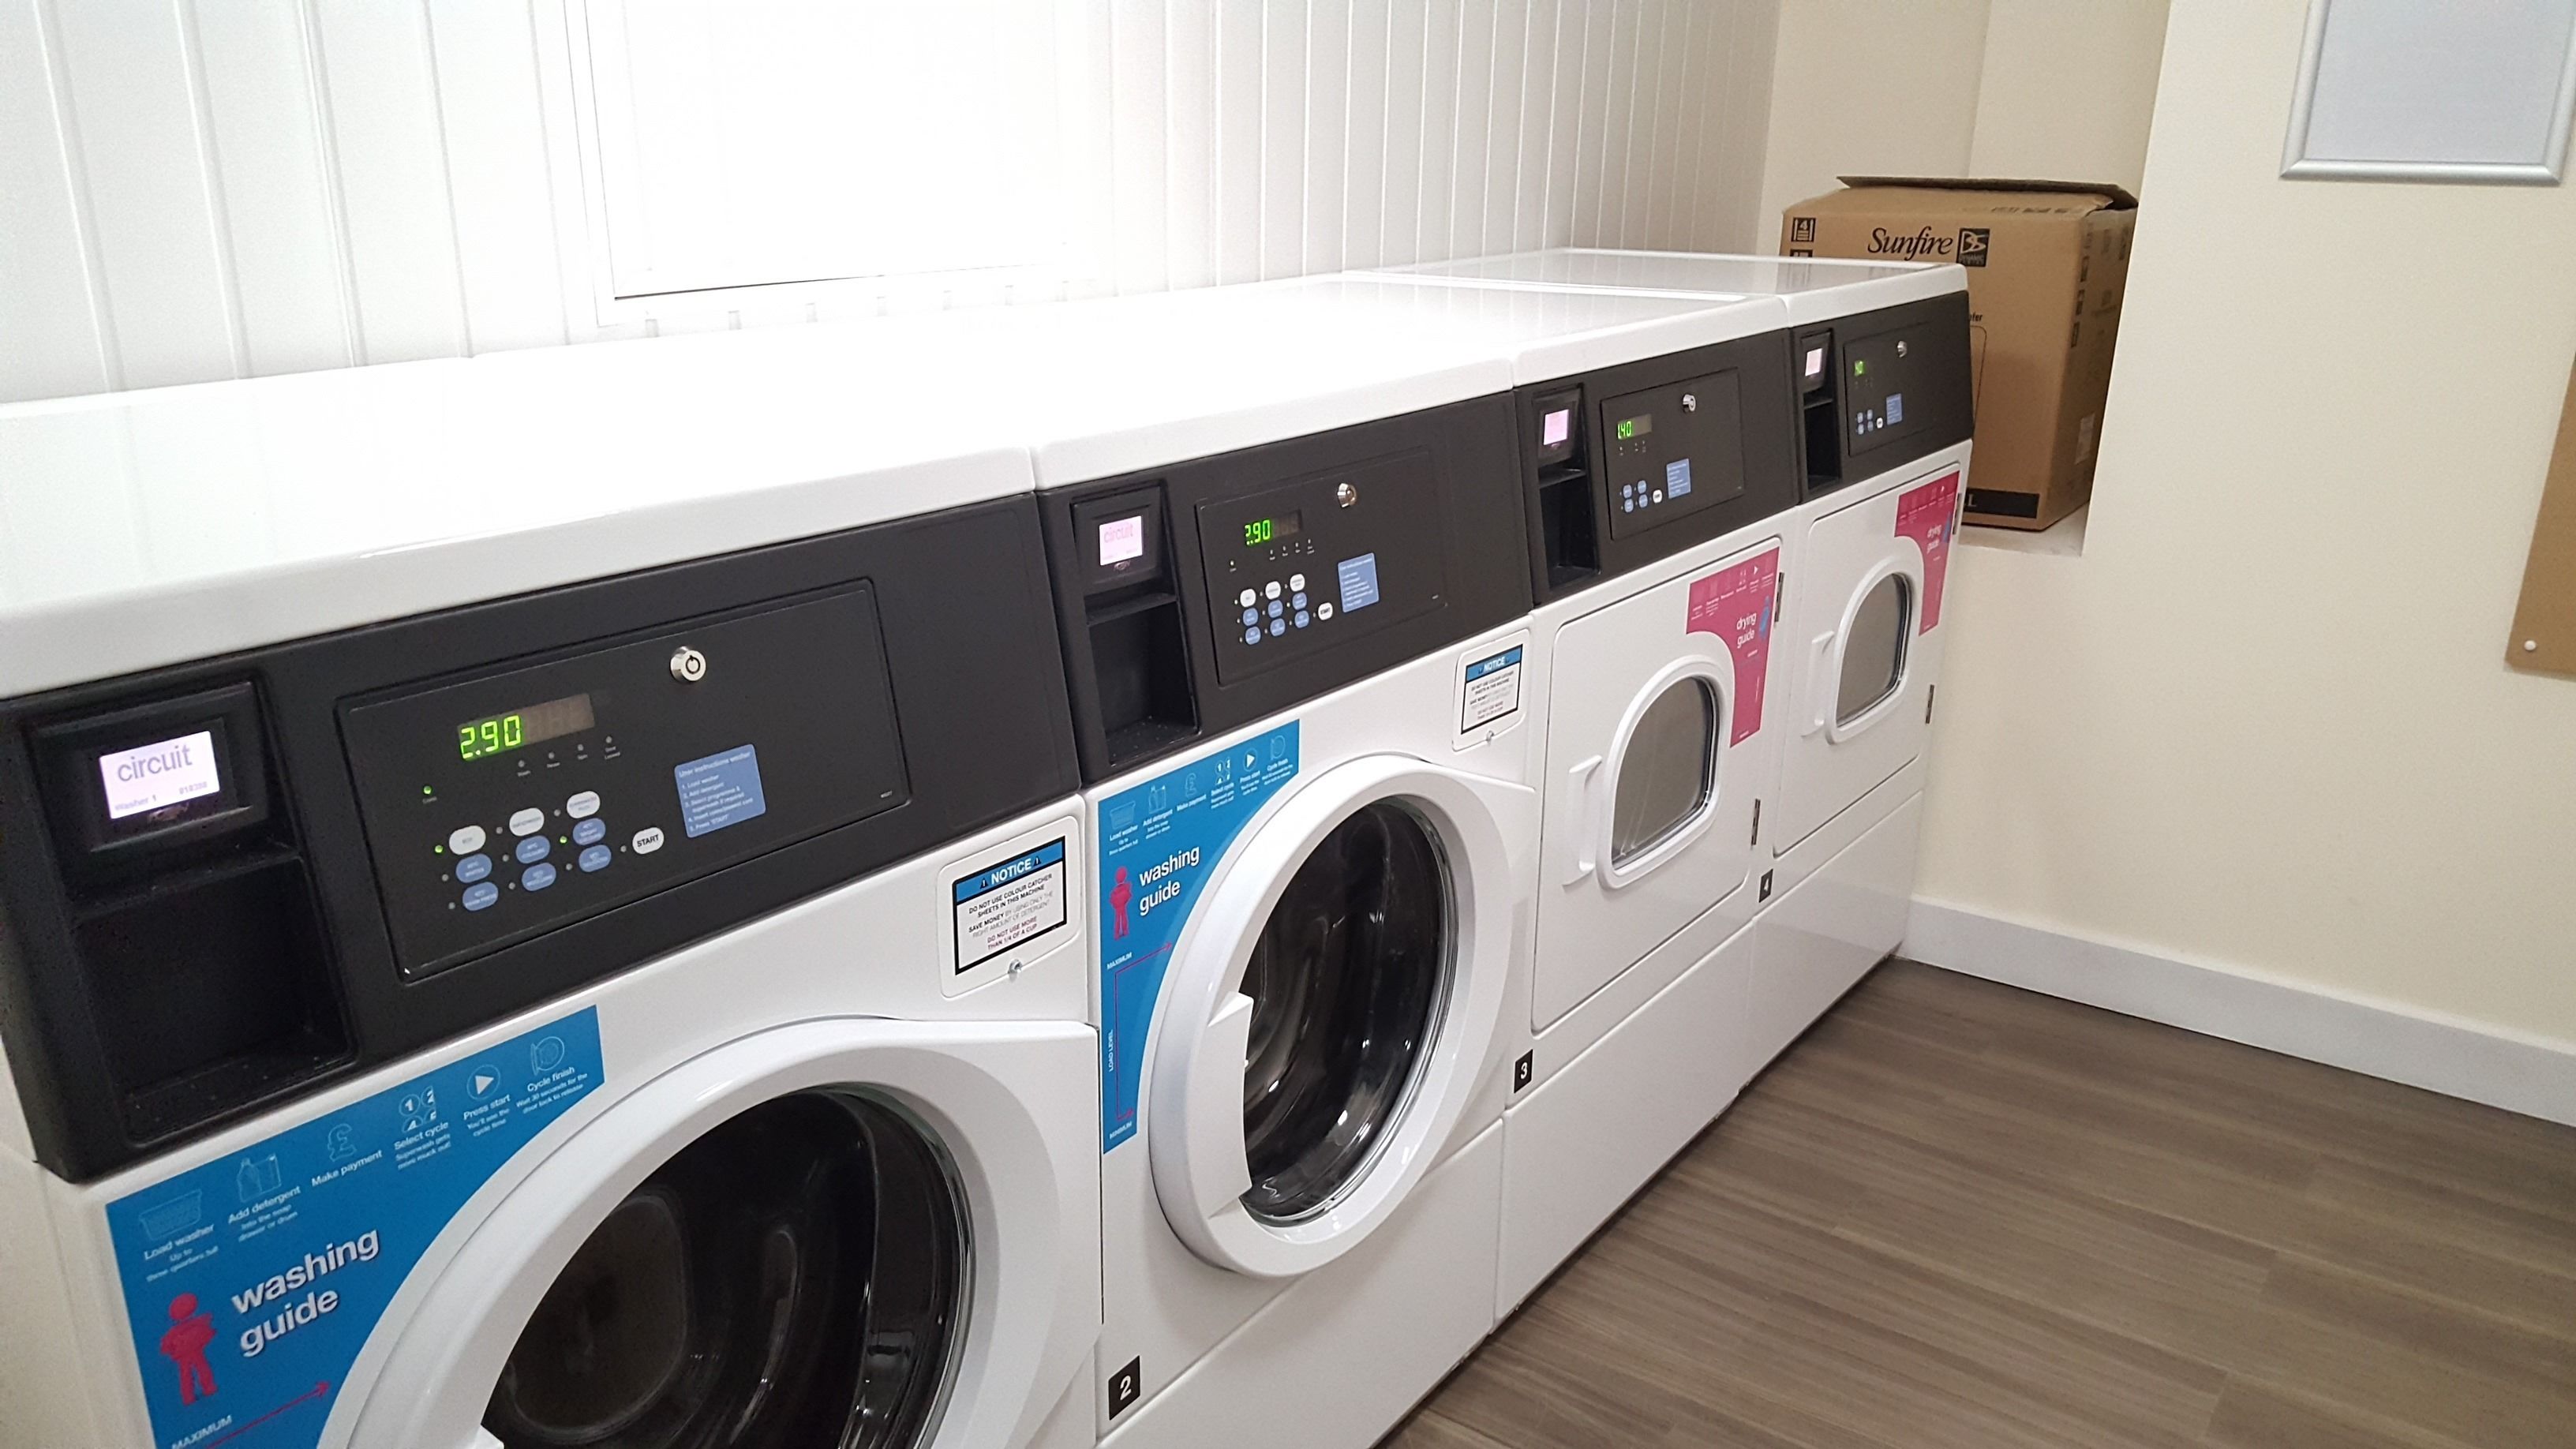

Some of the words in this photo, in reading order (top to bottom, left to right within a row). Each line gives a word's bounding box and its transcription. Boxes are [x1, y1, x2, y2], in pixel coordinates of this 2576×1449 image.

[1867, 226, 1953, 261] Sunfire
[1737, 612, 1757, 630] drying
[1737, 627, 1755, 649] guide
[1484, 656, 1506, 672] NOTICE
[460, 714, 522, 759] 2.90
[118, 744, 193, 783] circuit
[636, 833, 660, 848] START
[990, 858, 1032, 885] NOTICE
[1139, 846, 1200, 887] washing
[968, 905, 978, 914] DO
[979, 900, 990, 909] NOT
[991, 895, 1002, 904] USE
[1004, 885, 1027, 899] COLOUR
[1028, 874, 1053, 889] CATCHER
[977, 904, 999, 918] SHEETS
[1007, 895, 1020, 904] THIS
[1020, 884, 1045, 898] MACHINE
[1139, 881, 1181, 916] guide
[968, 923, 983, 933] SAVE
[984, 912, 1005, 924] MONEY
[997, 929, 1008, 938] NOT
[1009, 923, 1020, 933] USE
[1021, 916, 1037, 927] MORE
[987, 940, 1003, 950] THAN
[526, 1076, 551, 1092] Cycle
[552, 1066, 575, 1081] finish
[1520, 1061, 1528, 1080] 3
[463, 1104, 489, 1121] Press
[490, 1094, 511, 1109] start
[394, 1132, 424, 1151] Select
[425, 1121, 450, 1137] cycle
[311, 1168, 340, 1187] Make
[340, 1150, 383, 1177] payment
[227, 1207, 249, 1224] Add
[251, 1185, 301, 1212] detergent
[144, 1240, 174, 1261] Load
[174, 1223, 215, 1247] washer
[230, 1229, 380, 1315] washing
[239, 1288, 339, 1358] guide
[1120, 1375, 1132, 1401] 2
[171, 1415, 233, 1449] MAXIMUM
